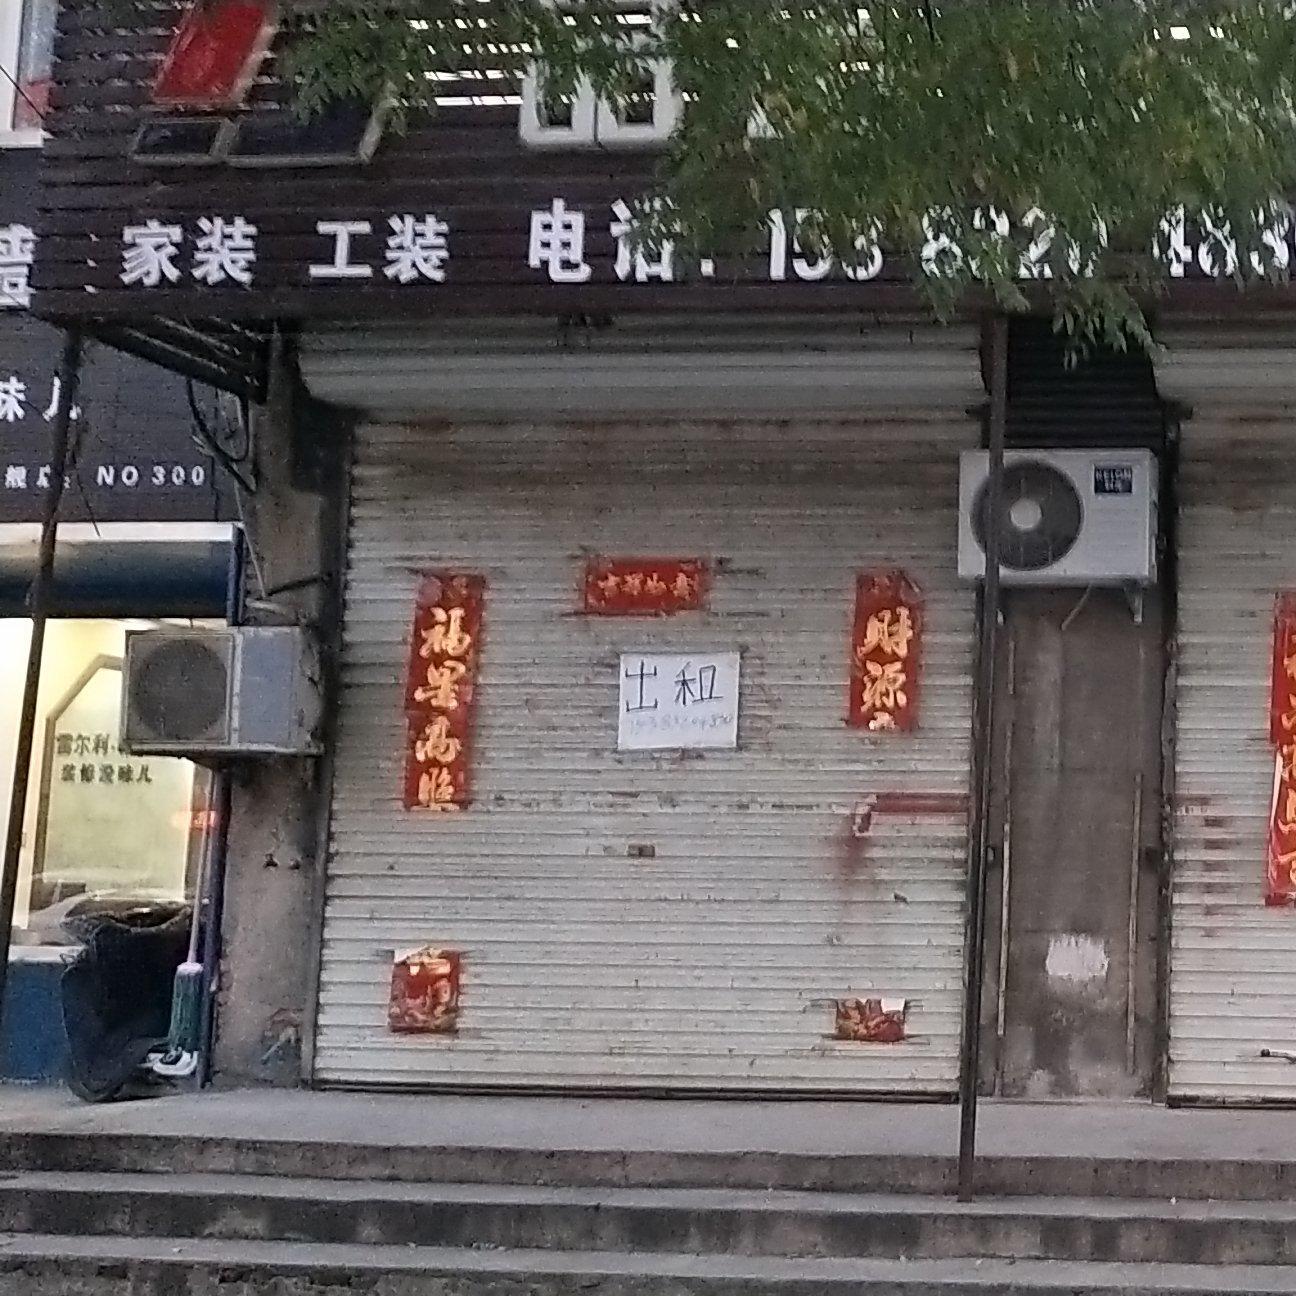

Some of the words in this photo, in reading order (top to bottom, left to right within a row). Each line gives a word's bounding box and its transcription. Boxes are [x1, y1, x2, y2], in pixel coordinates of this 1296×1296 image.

[119, 217, 258, 289] 家装
[308, 214, 450, 284] 工装
[625, 659, 724, 713] 出租
